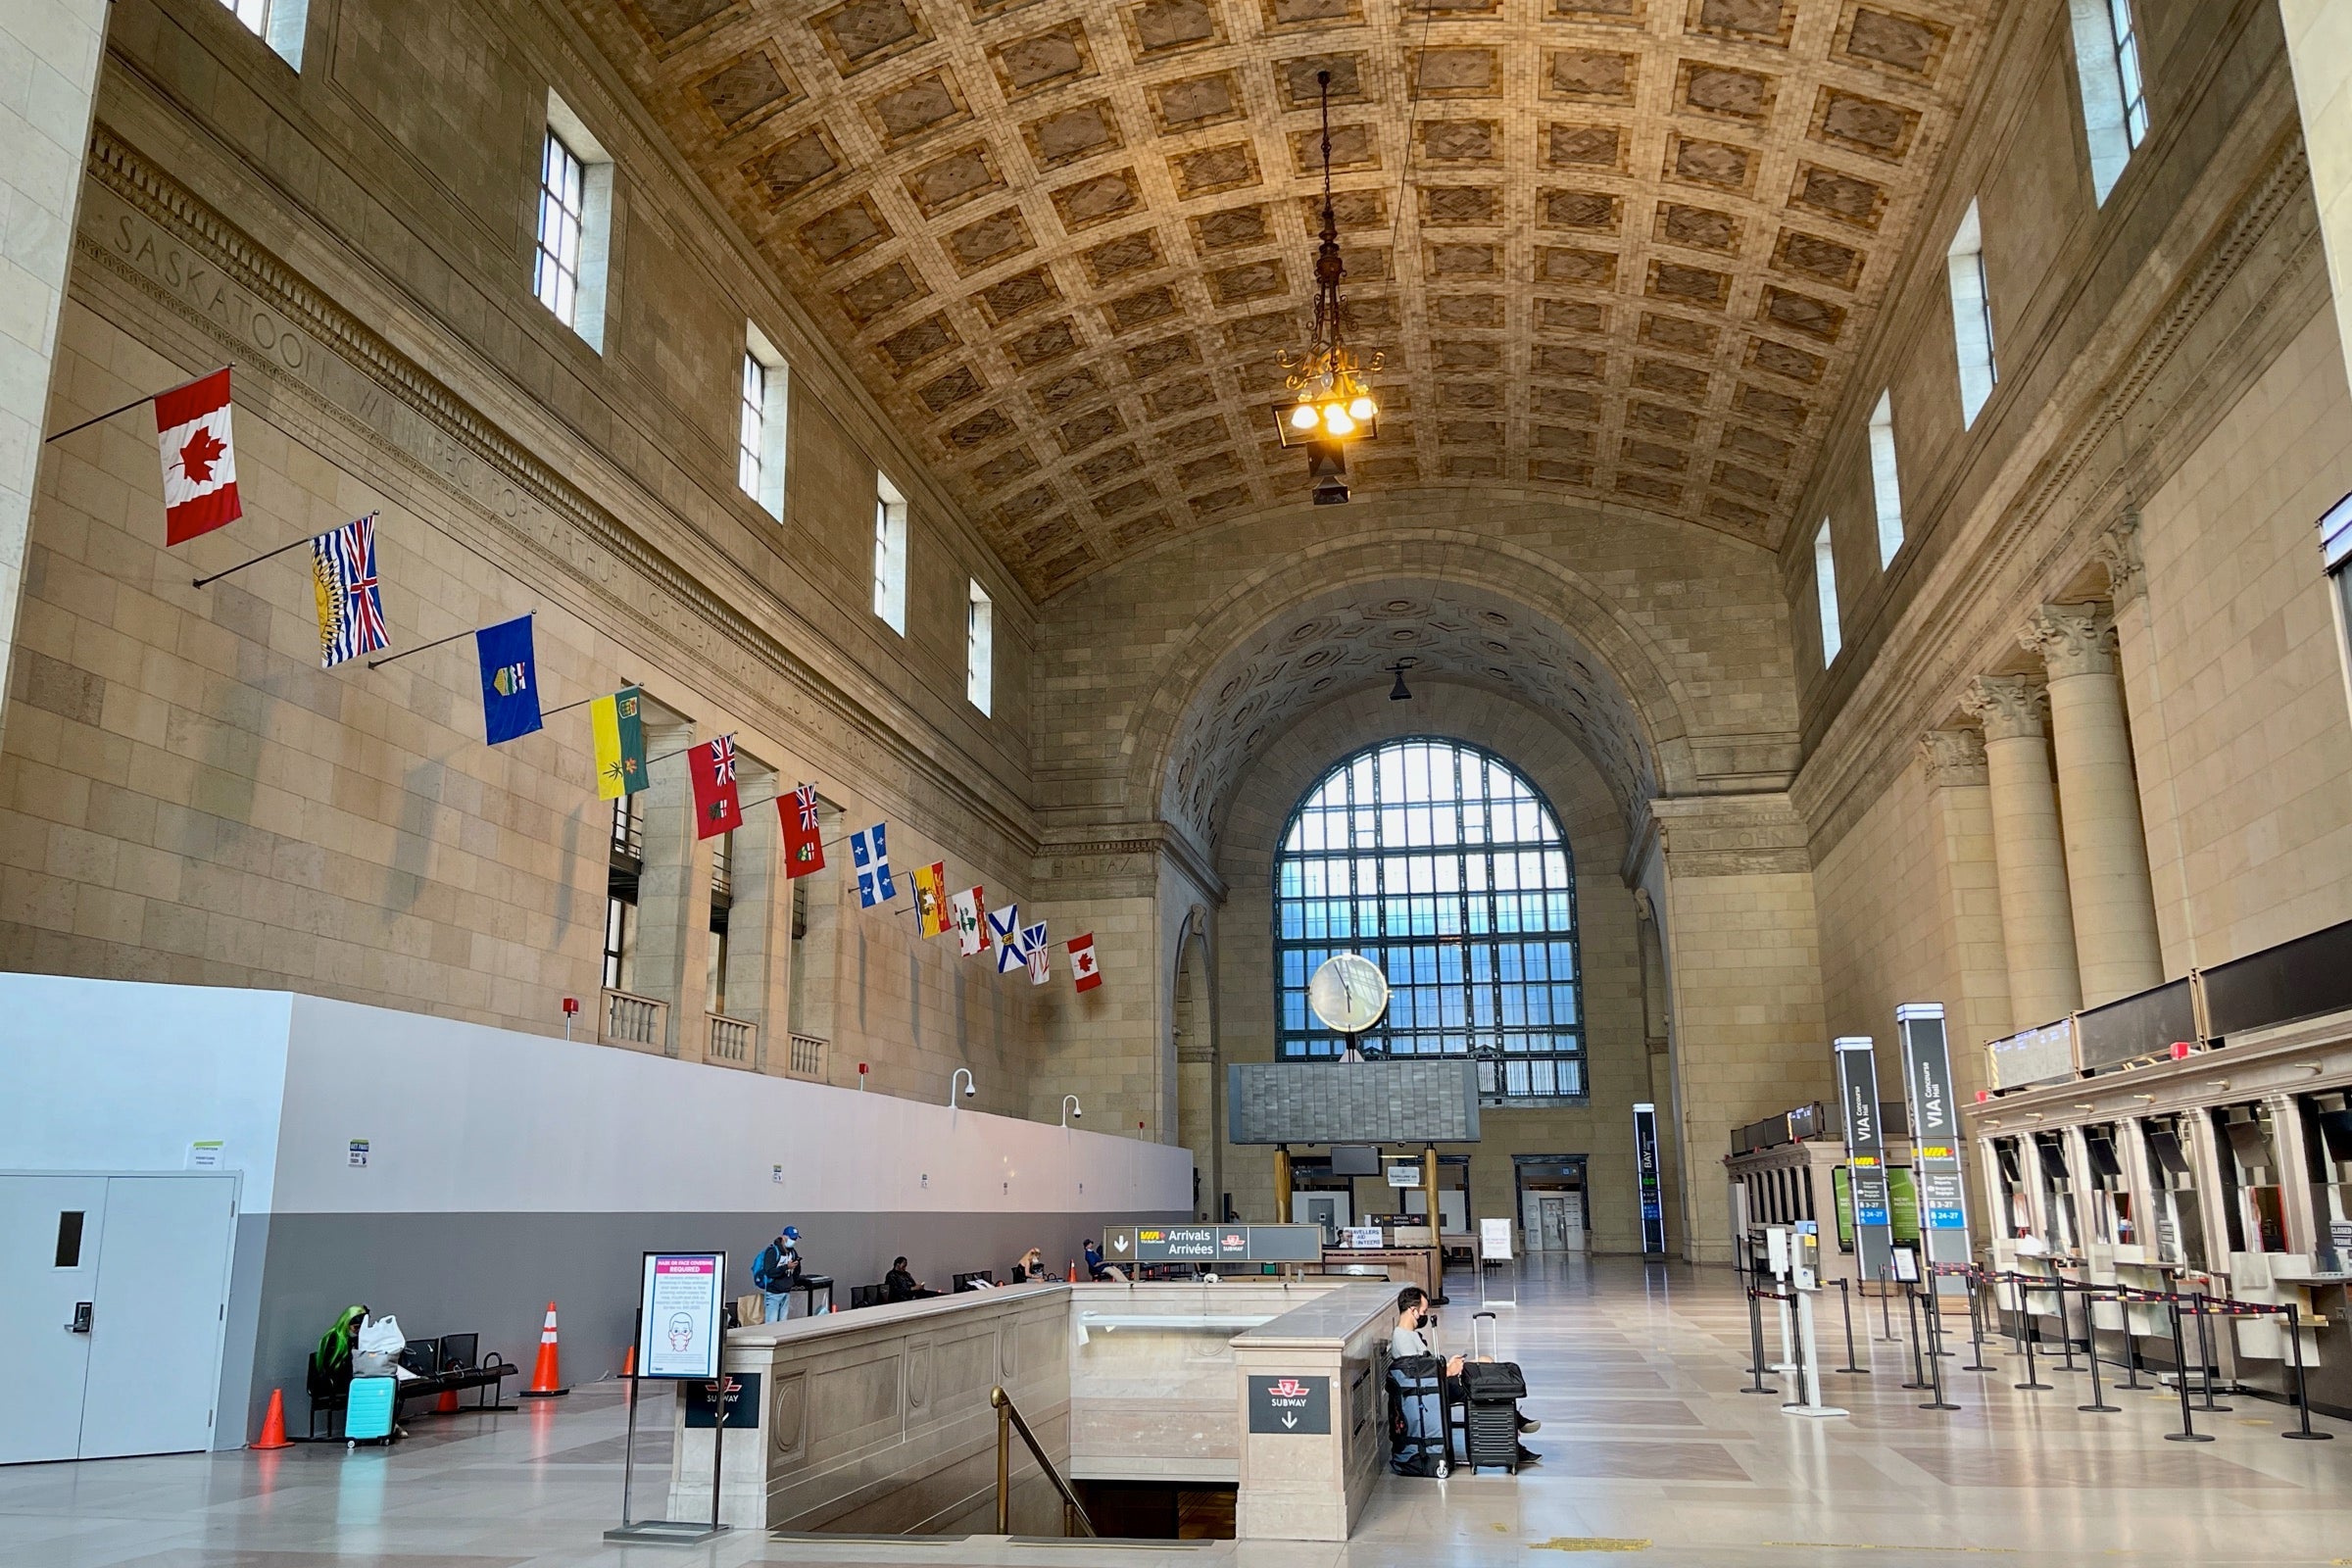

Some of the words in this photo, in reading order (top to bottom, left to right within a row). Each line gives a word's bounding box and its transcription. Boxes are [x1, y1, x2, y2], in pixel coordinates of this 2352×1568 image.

[113, 214, 327, 390] SASKATOON
[1923, 1061, 1933, 1098] Concourse
[1932, 1084, 1940, 1098] Hall
[1926, 1099, 1943, 1128] VIA
[1857, 1117, 1872, 1142] VIA
[1642, 1151, 1652, 1168] BAY
[1141, 1231, 1159, 1240] VIA
[1168, 1230, 1210, 1241] Arrivals
[1168, 1243, 1213, 1254] Arrivées
[1271, 1398, 1306, 1407] SUBWAY
